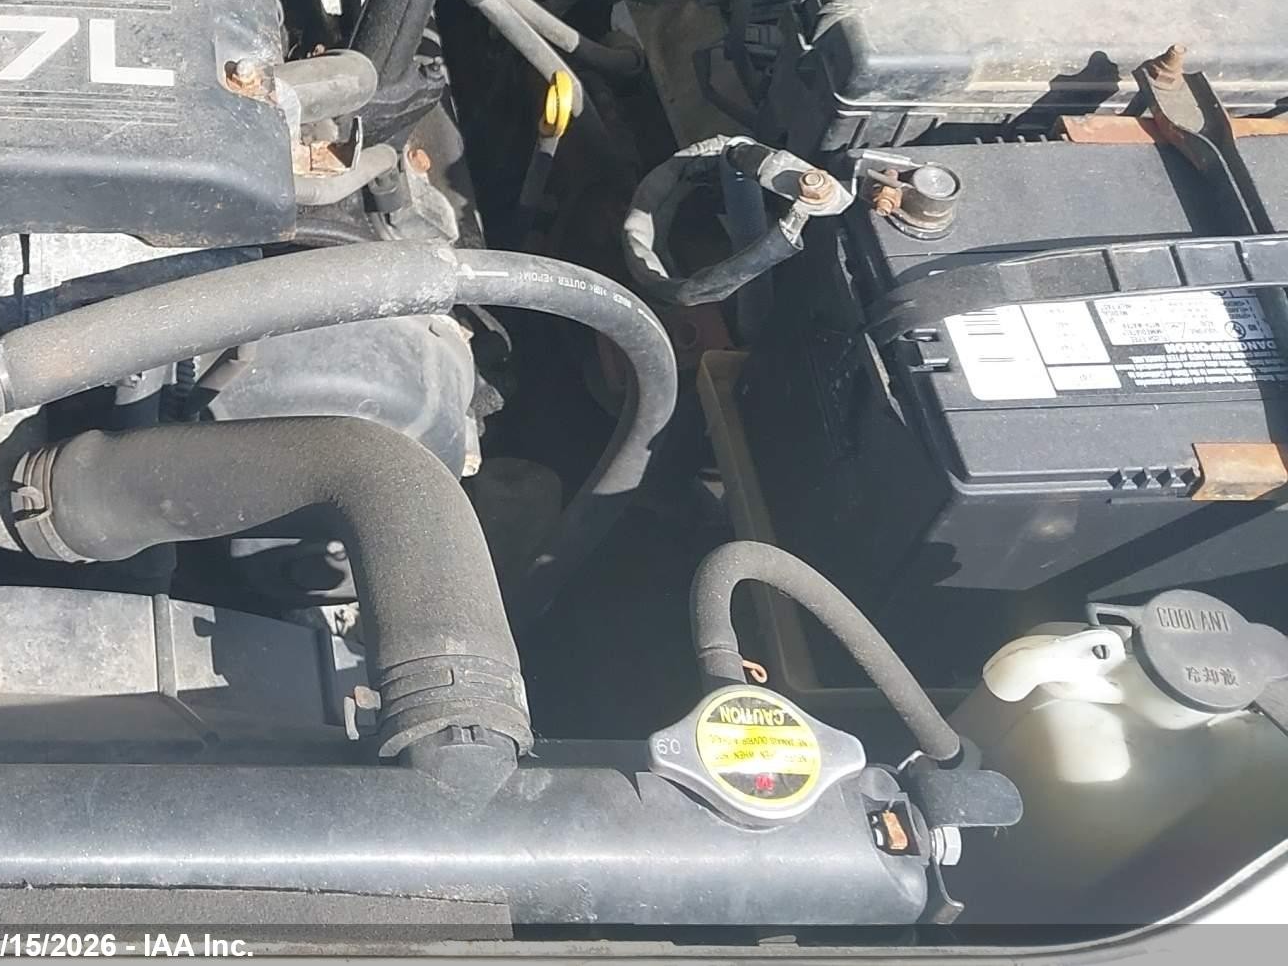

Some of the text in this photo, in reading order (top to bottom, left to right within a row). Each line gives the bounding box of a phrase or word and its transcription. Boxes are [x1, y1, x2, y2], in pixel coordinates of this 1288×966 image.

[558, 276, 586, 290] OUTER
[1157, 607, 1229, 632] COOLANT
[719, 705, 785, 726] CAUTION
